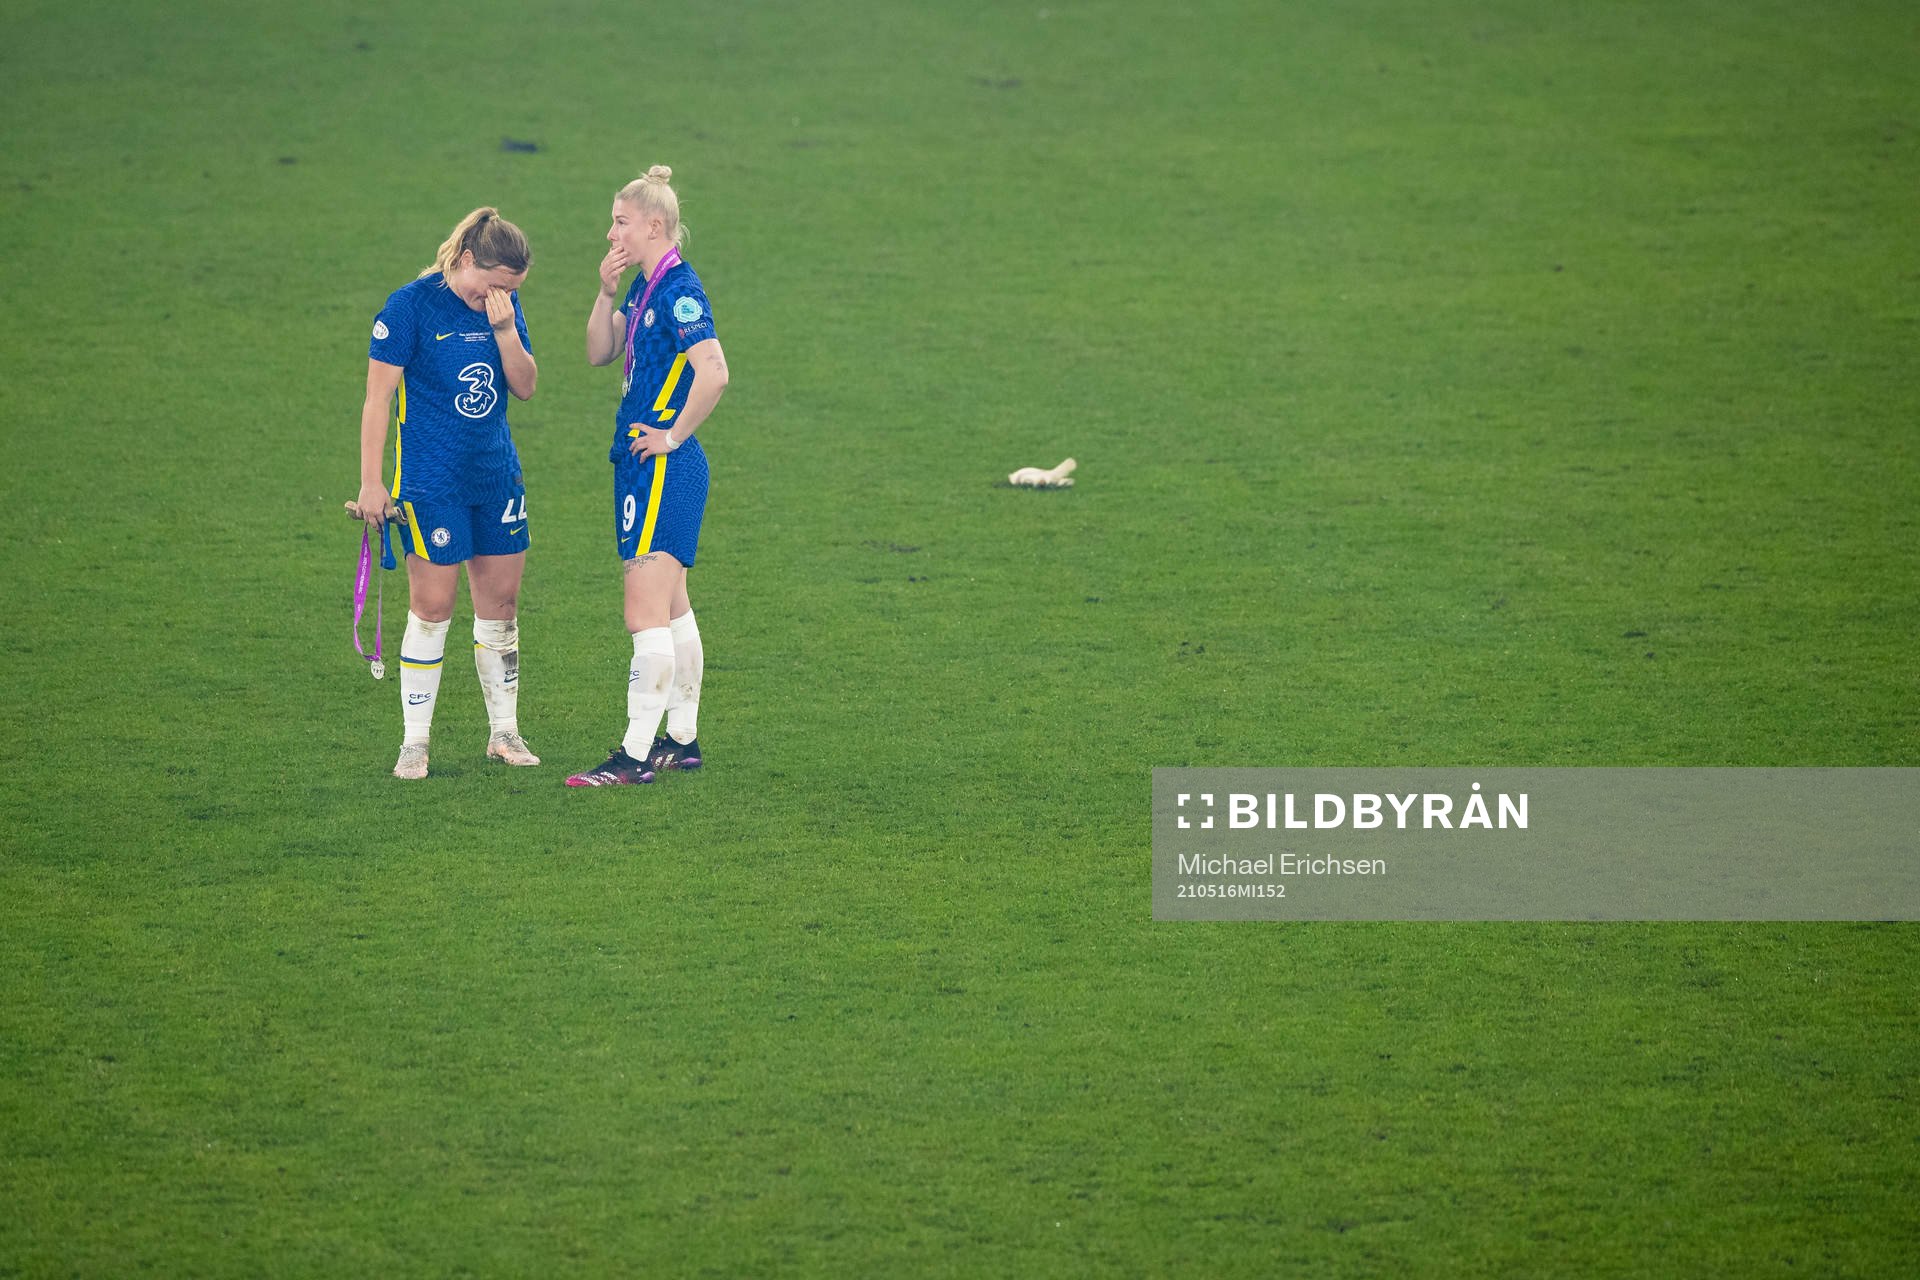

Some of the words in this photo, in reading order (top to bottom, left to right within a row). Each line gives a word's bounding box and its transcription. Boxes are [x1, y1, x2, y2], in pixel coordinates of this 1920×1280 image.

[454, 362, 498, 419] 3
[622, 494, 636, 532] 9
[409, 692, 432, 700] CFC
